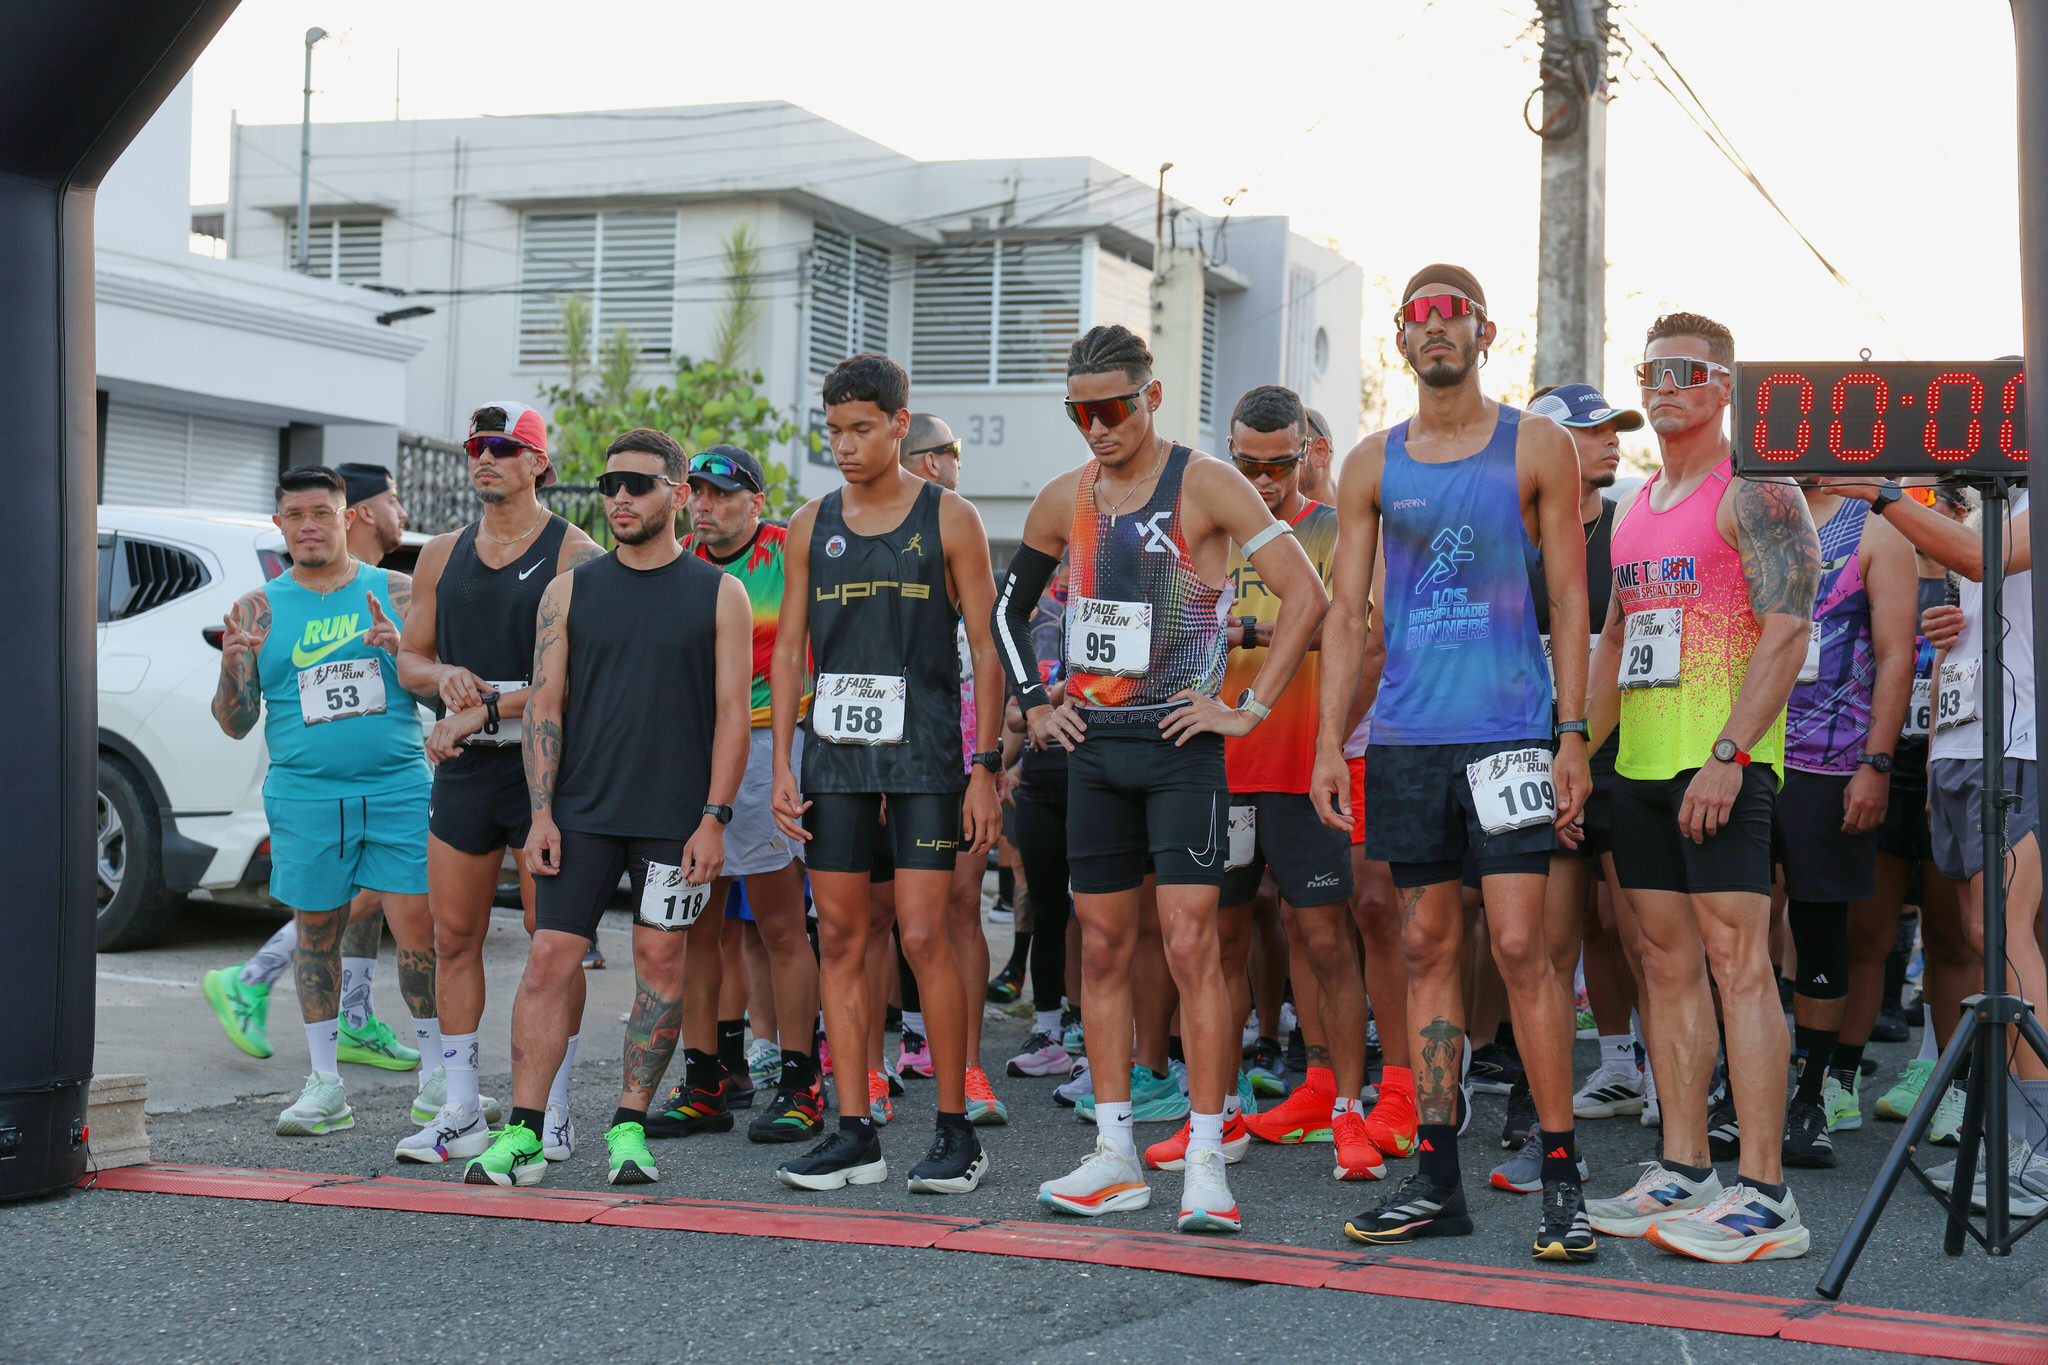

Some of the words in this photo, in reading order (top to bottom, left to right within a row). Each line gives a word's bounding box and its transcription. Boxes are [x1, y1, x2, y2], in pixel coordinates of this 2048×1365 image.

[968, 415, 1005, 446] 33
[1661, 556, 1695, 581] RUN
[1674, 582, 1698, 594] SHOP
[1432, 587, 1468, 609] LOS
[1091, 602, 1119, 615] FADE
[1101, 616, 1130, 626] RUN
[1636, 613, 1656, 627] FADE
[303, 613, 359, 646] RUN
[1406, 617, 1490, 651] RUNNERS
[1643, 625, 1664, 636] RUN
[1086, 632, 1116, 663] 95
[1628, 644, 1653, 676] 29
[326, 662, 354, 675] FADE
[341, 671, 365, 680] RUN
[847, 677, 876, 689] FADE
[1913, 681, 1931, 692] FA
[326, 685, 360, 711] 53
[858, 688, 887, 699] RUN
[1940, 689, 1960, 719] 93
[832, 704, 883, 734] 158
[1087, 711, 1127, 724] NIKE
[1127, 708, 1171, 724] PRO
[1505, 751, 1539, 766] FADE
[1526, 762, 1549, 773] RUN
[1498, 780, 1555, 817] 109
[916, 839, 959, 851] upr
[664, 892, 703, 920] 118
